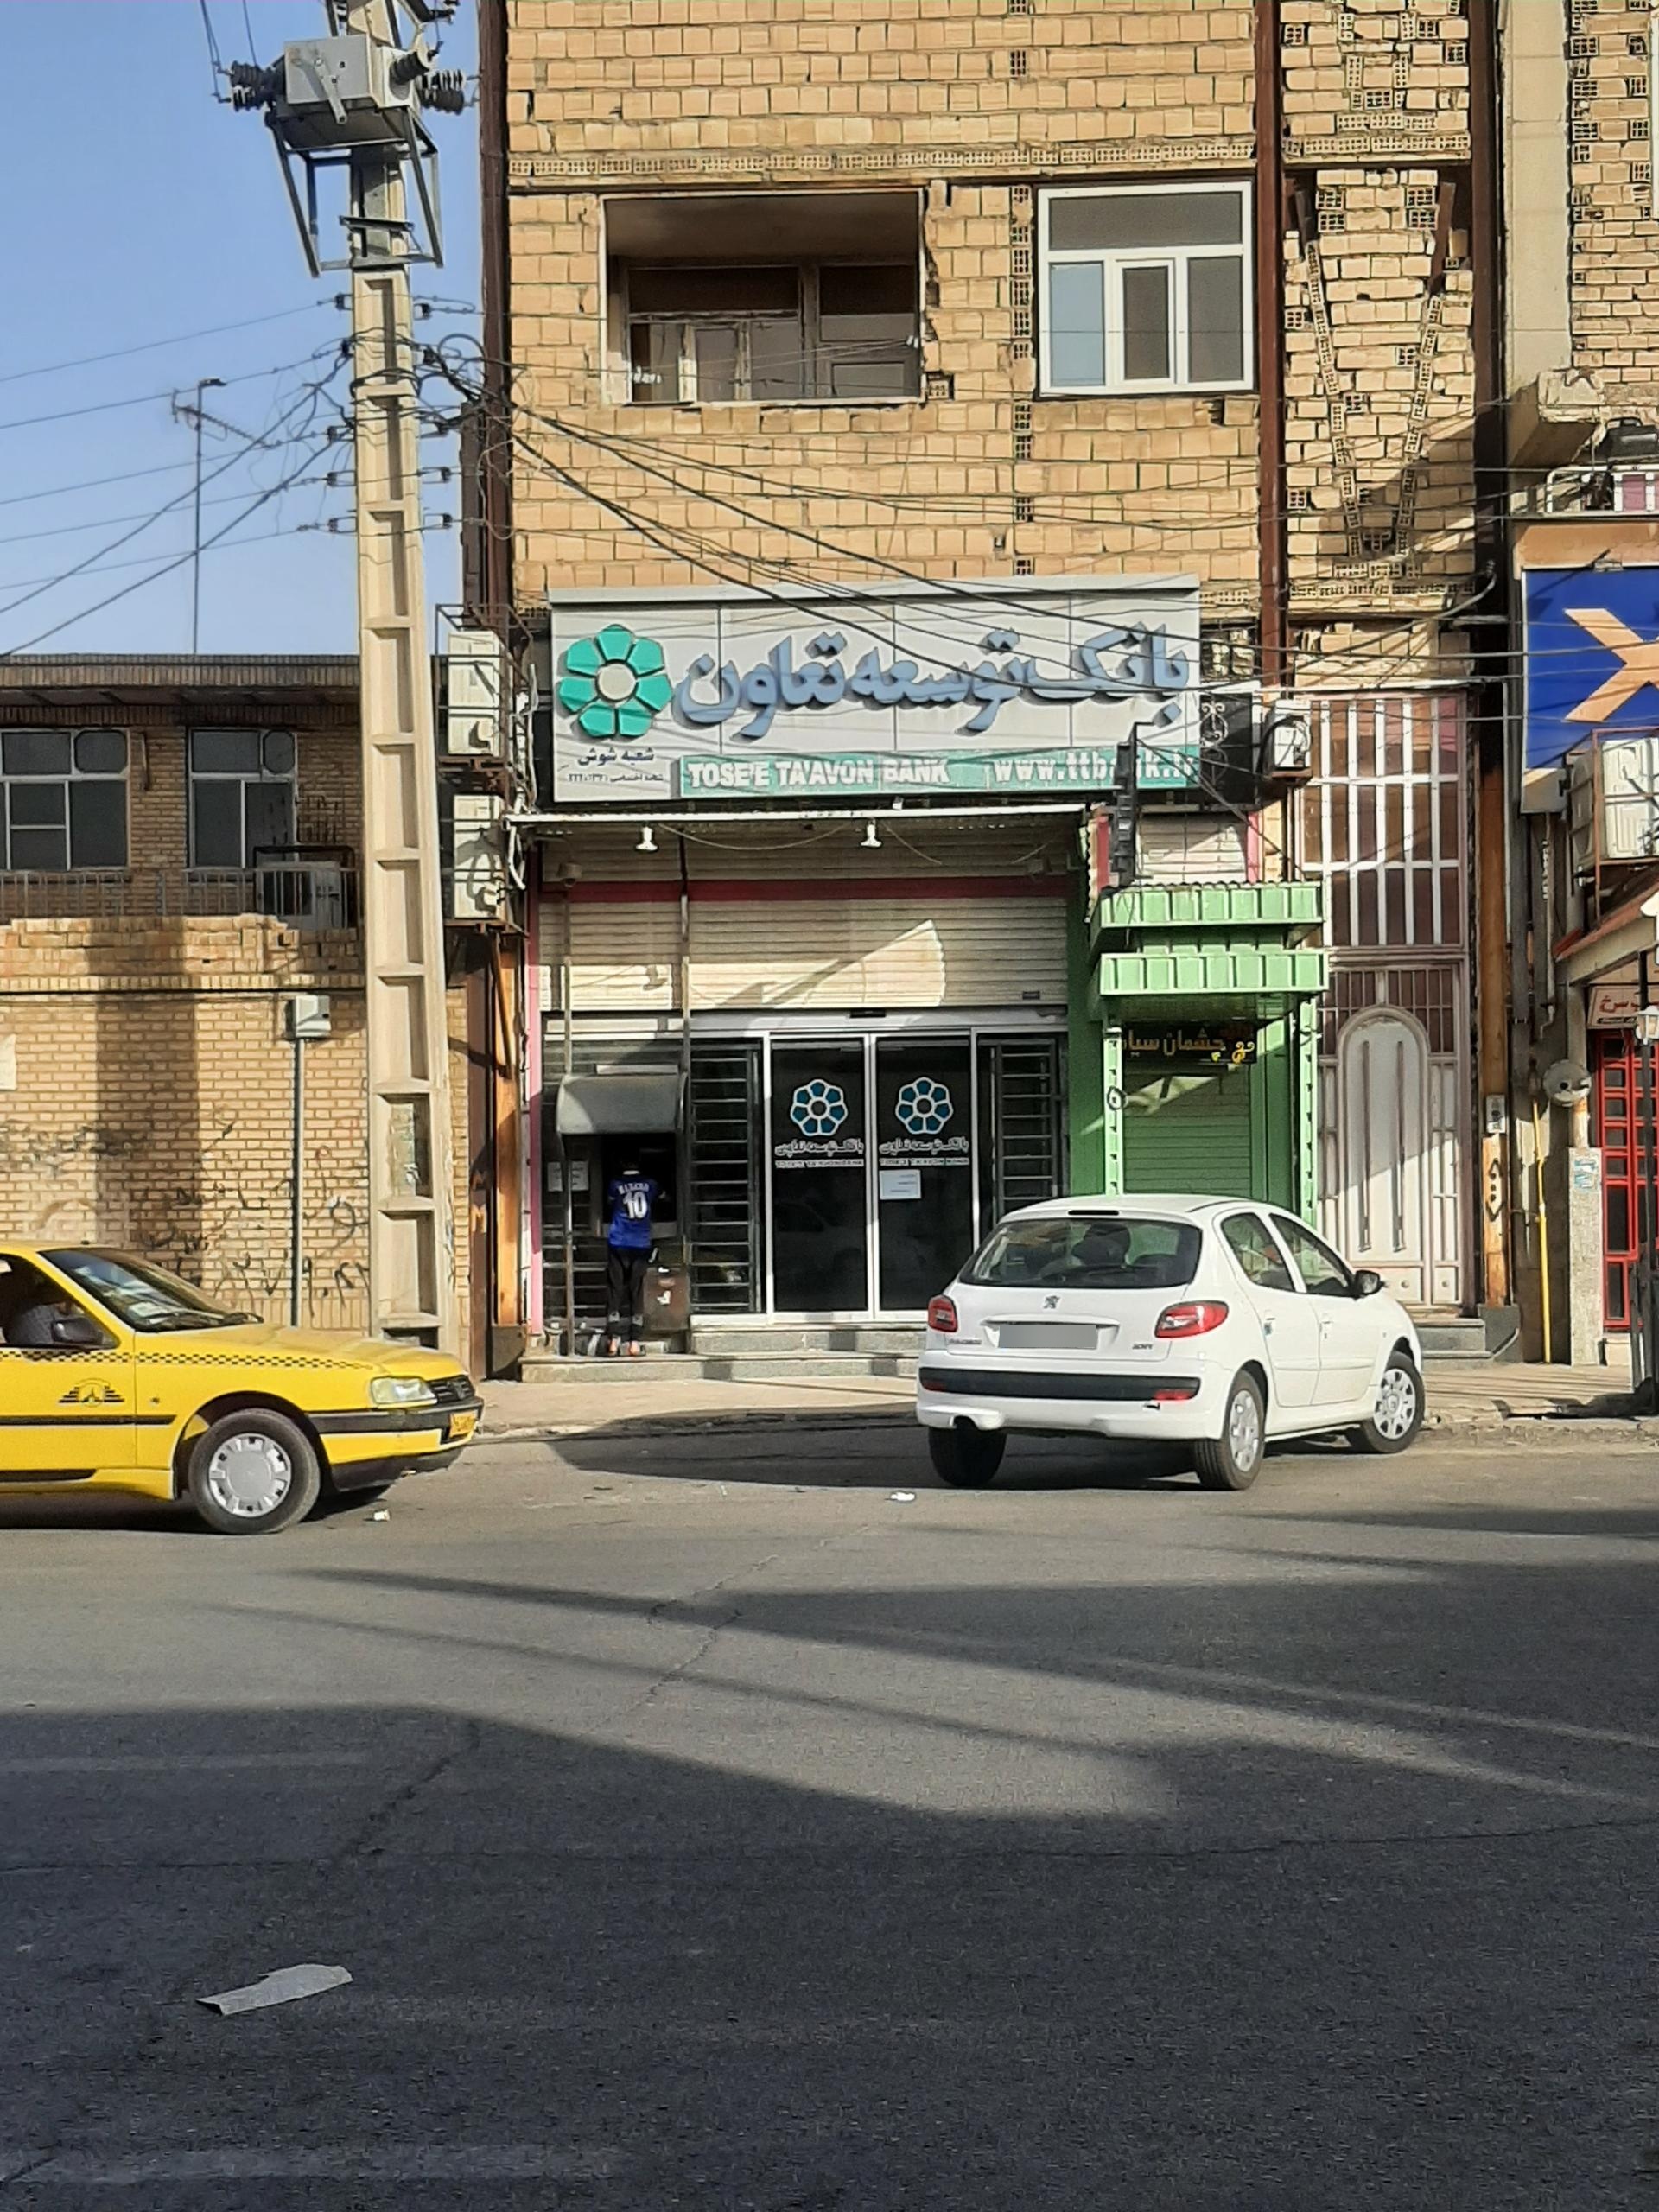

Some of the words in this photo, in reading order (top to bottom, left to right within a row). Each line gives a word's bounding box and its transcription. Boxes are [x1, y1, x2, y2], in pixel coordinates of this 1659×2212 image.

[674, 632, 846, 741] تعاون
[849, 628, 1023, 734] توسعه
[1027, 621, 1189, 724] بانک
[577, 747, 617, 766] شوش
[620, 747, 655, 766] شعبه
[774, 759, 874, 786] TA'AVON
[880, 758, 950, 784] BANK
[994, 750, 1194, 783] www.ttbk.ir
[1122, 1029, 1160, 1058] سیا
[623, 1192, 648, 1219] 10
